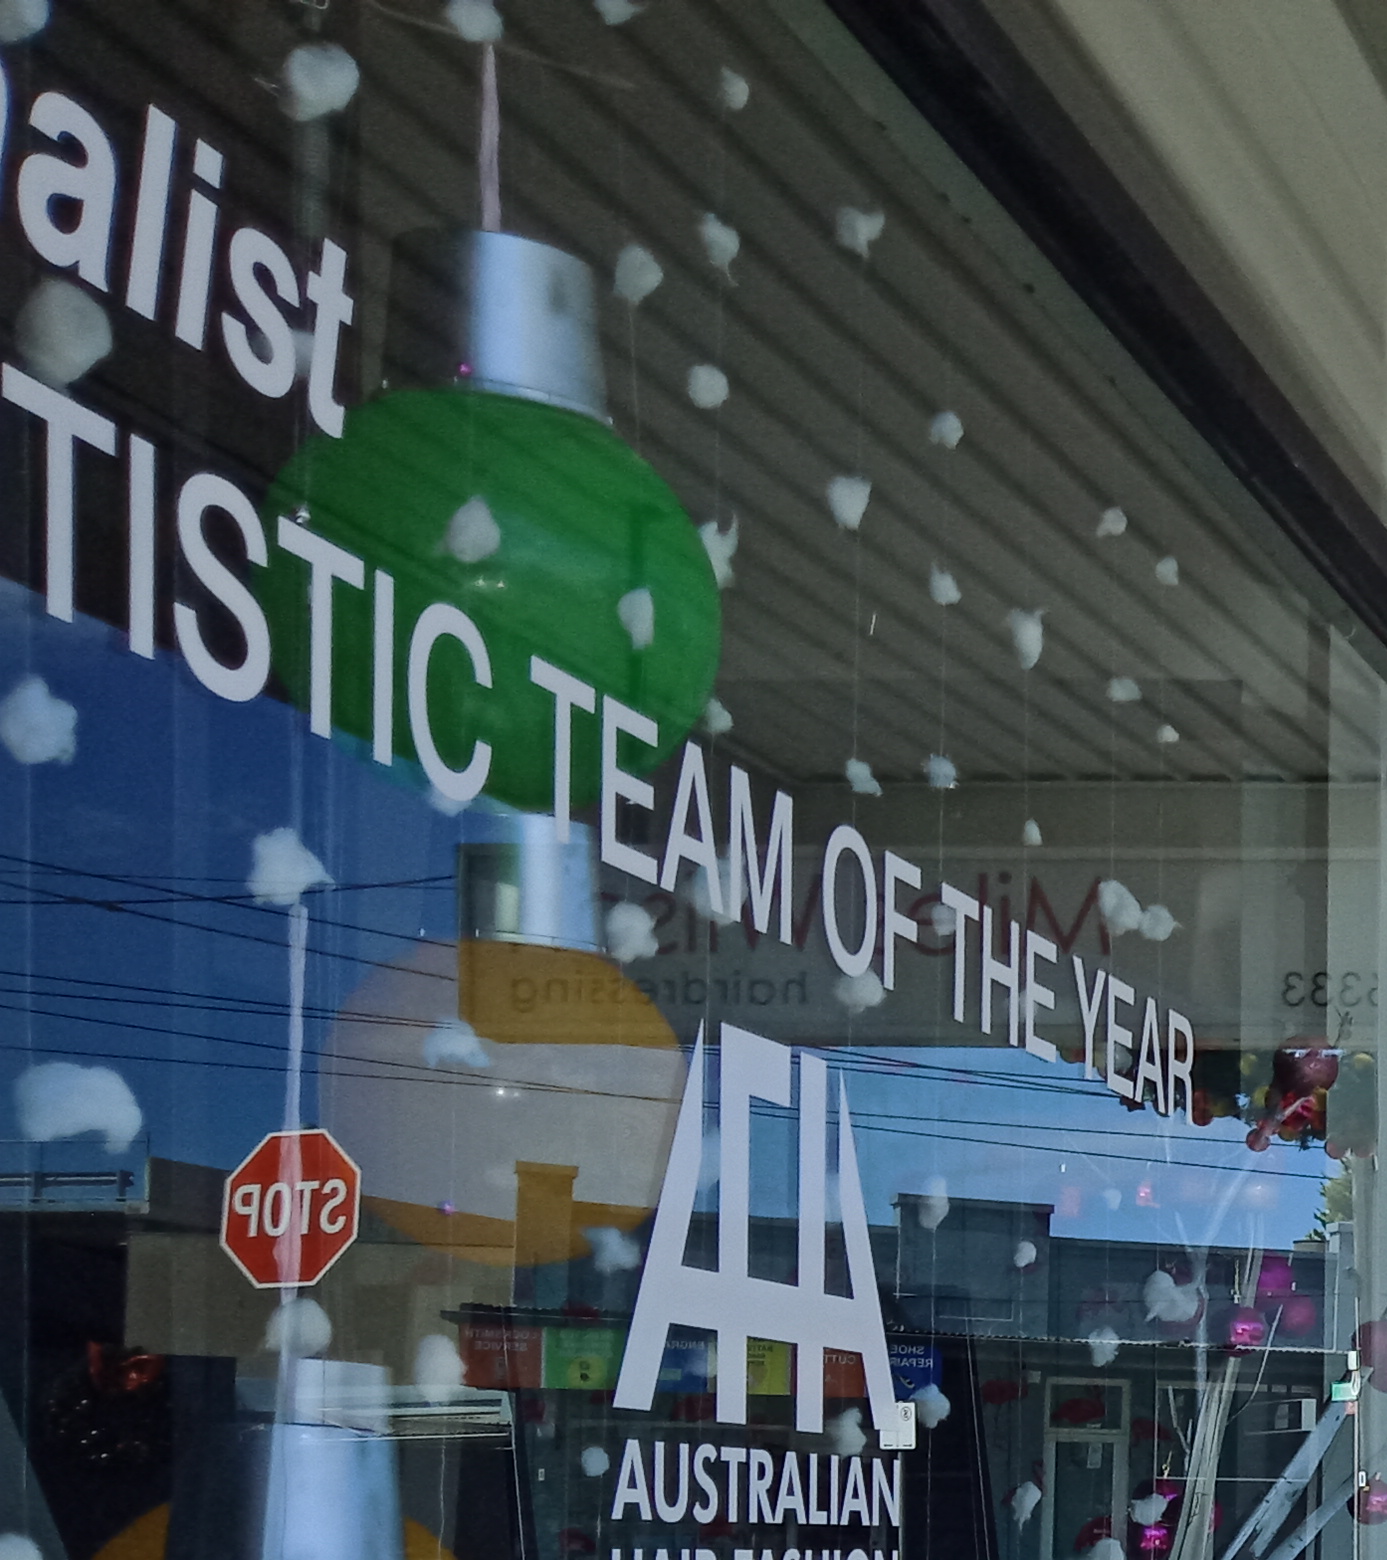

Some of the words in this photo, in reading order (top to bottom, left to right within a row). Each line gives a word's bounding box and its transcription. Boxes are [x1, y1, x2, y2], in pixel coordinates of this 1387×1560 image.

[0, 55, 353, 438] alist
[529, 655, 794, 945] TEAM
[822, 824, 922, 990] OF
[941, 882, 1058, 1063] THE
[1072, 953, 1194, 1126] YEAR
[612, 1438, 901, 1527] AUSTRALIAN
